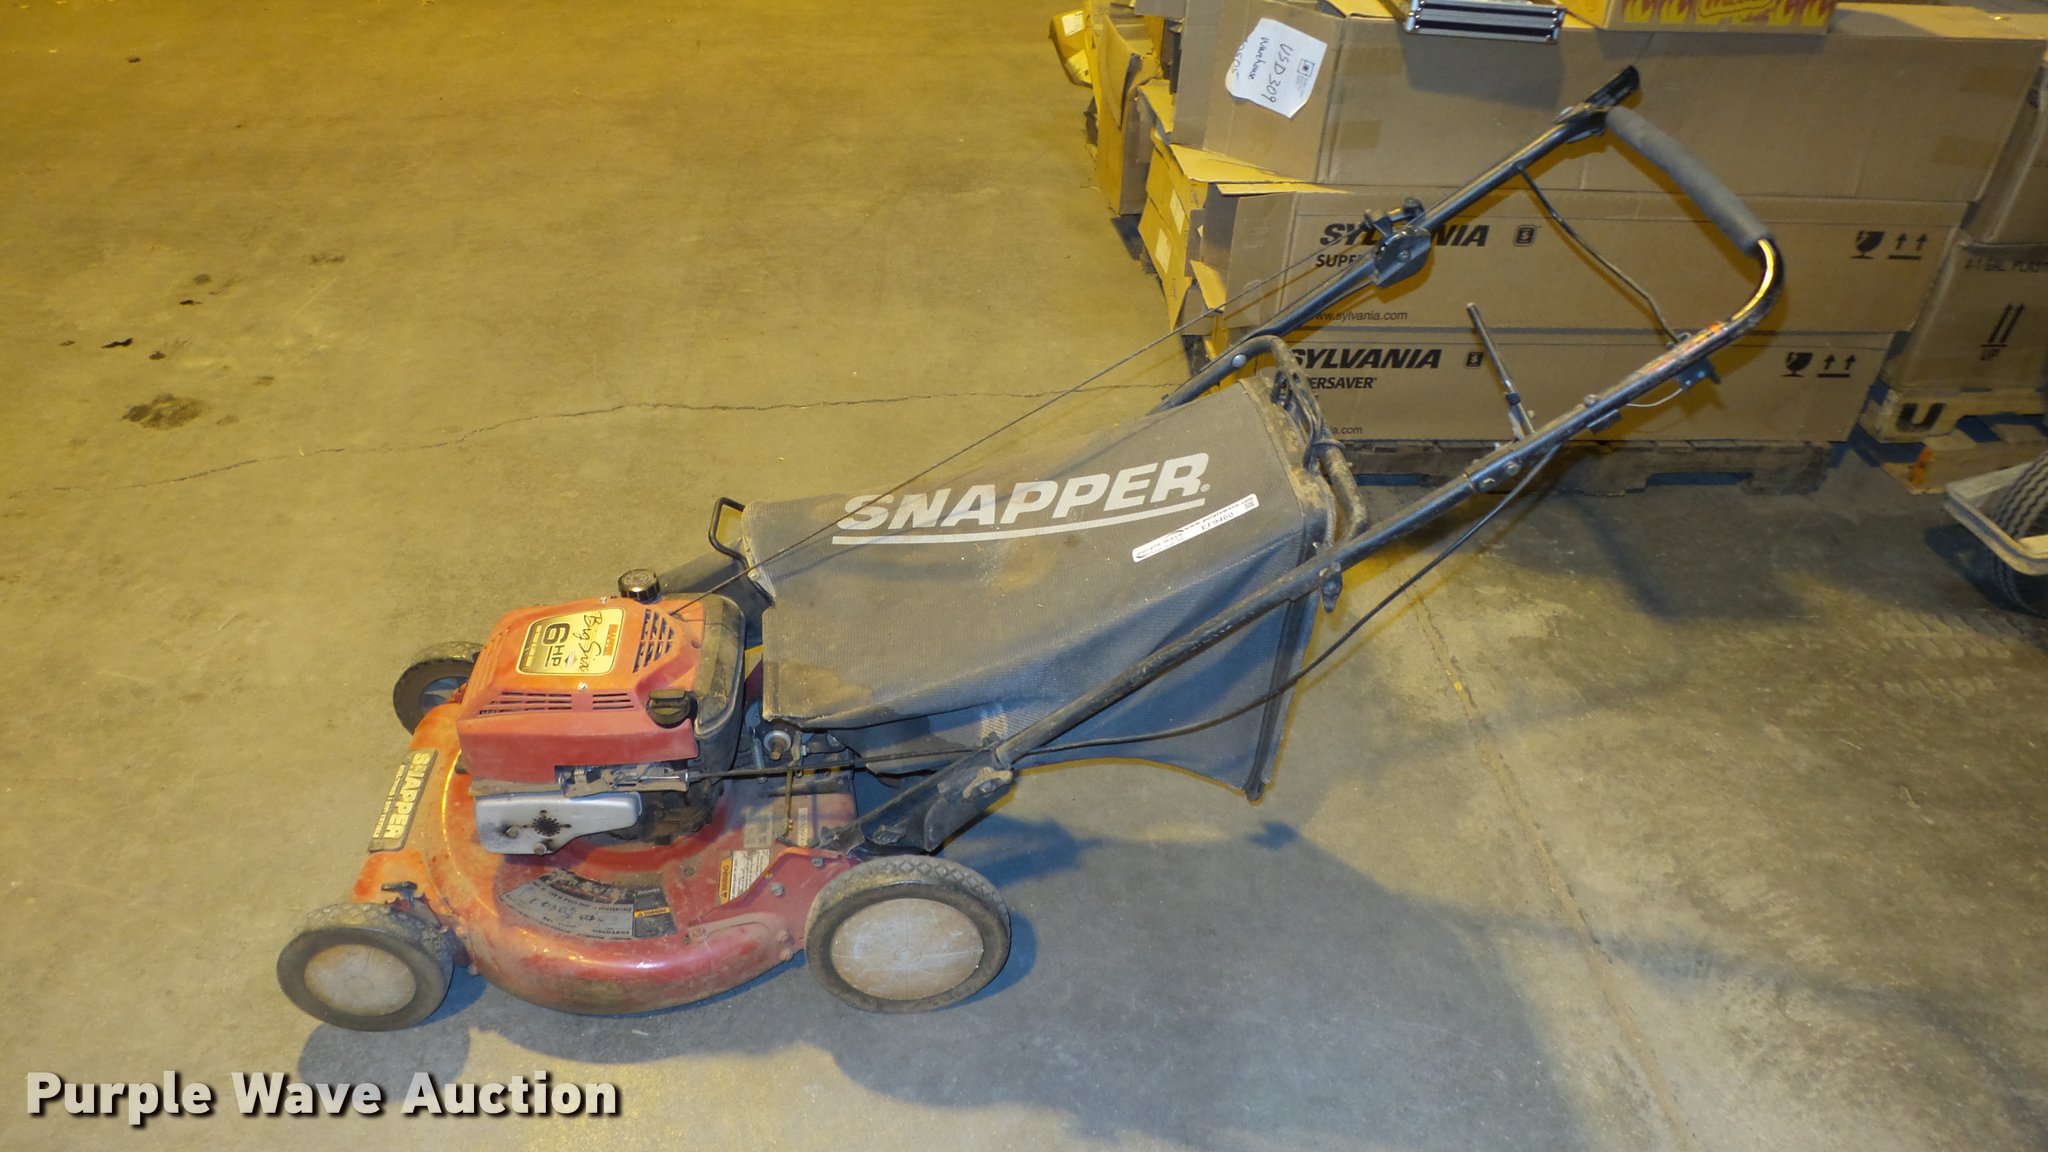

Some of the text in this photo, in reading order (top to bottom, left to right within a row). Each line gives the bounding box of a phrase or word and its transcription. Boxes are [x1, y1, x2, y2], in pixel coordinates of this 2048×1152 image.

[1260, 73, 1281, 103] 309
[542, 622, 571, 667] 6 HP
[573, 611, 603, 673] Big Six
[383, 752, 431, 839] SNAPPER
